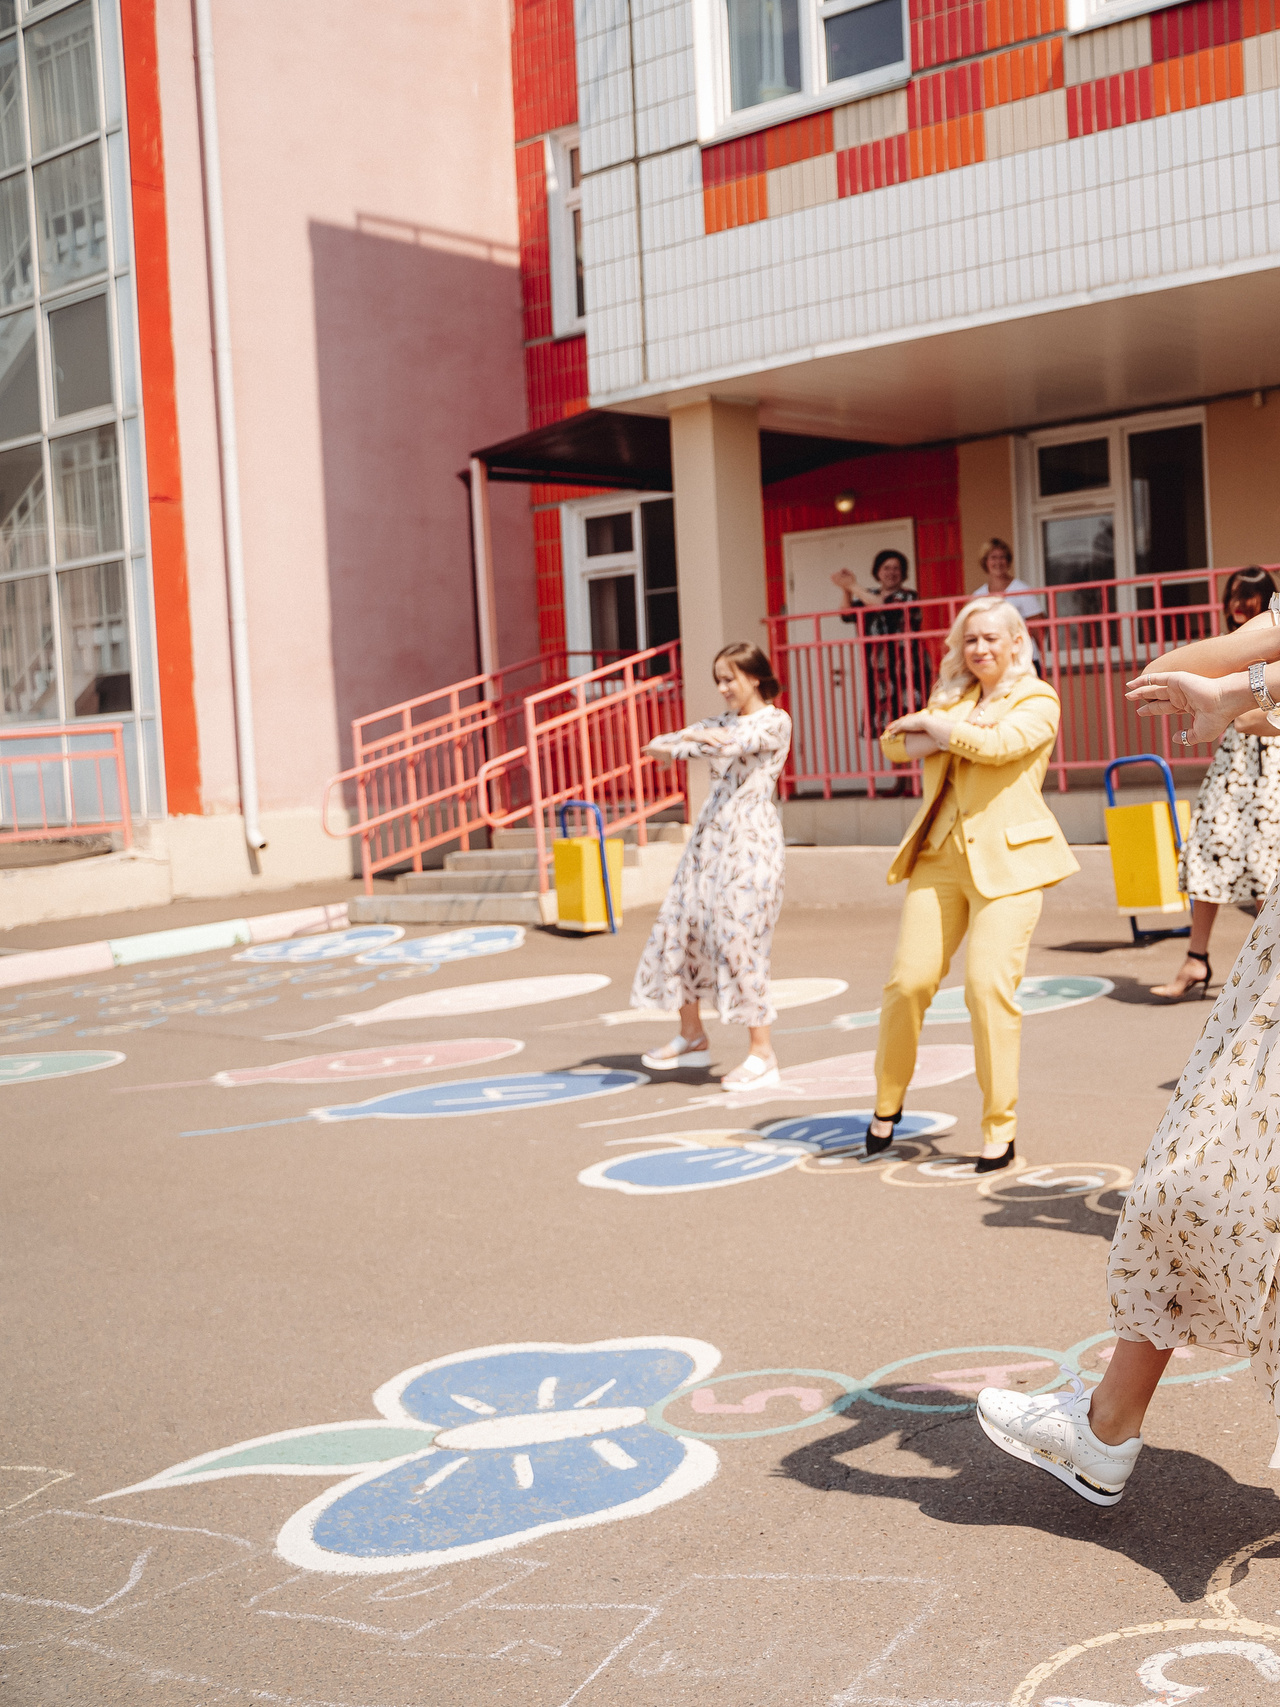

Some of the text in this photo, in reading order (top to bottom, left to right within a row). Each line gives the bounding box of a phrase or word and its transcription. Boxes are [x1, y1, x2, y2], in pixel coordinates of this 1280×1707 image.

[1016, 1168, 1105, 1193] 5
[691, 1387, 824, 1416] 5
[1063, 1459, 1074, 1470] 483
